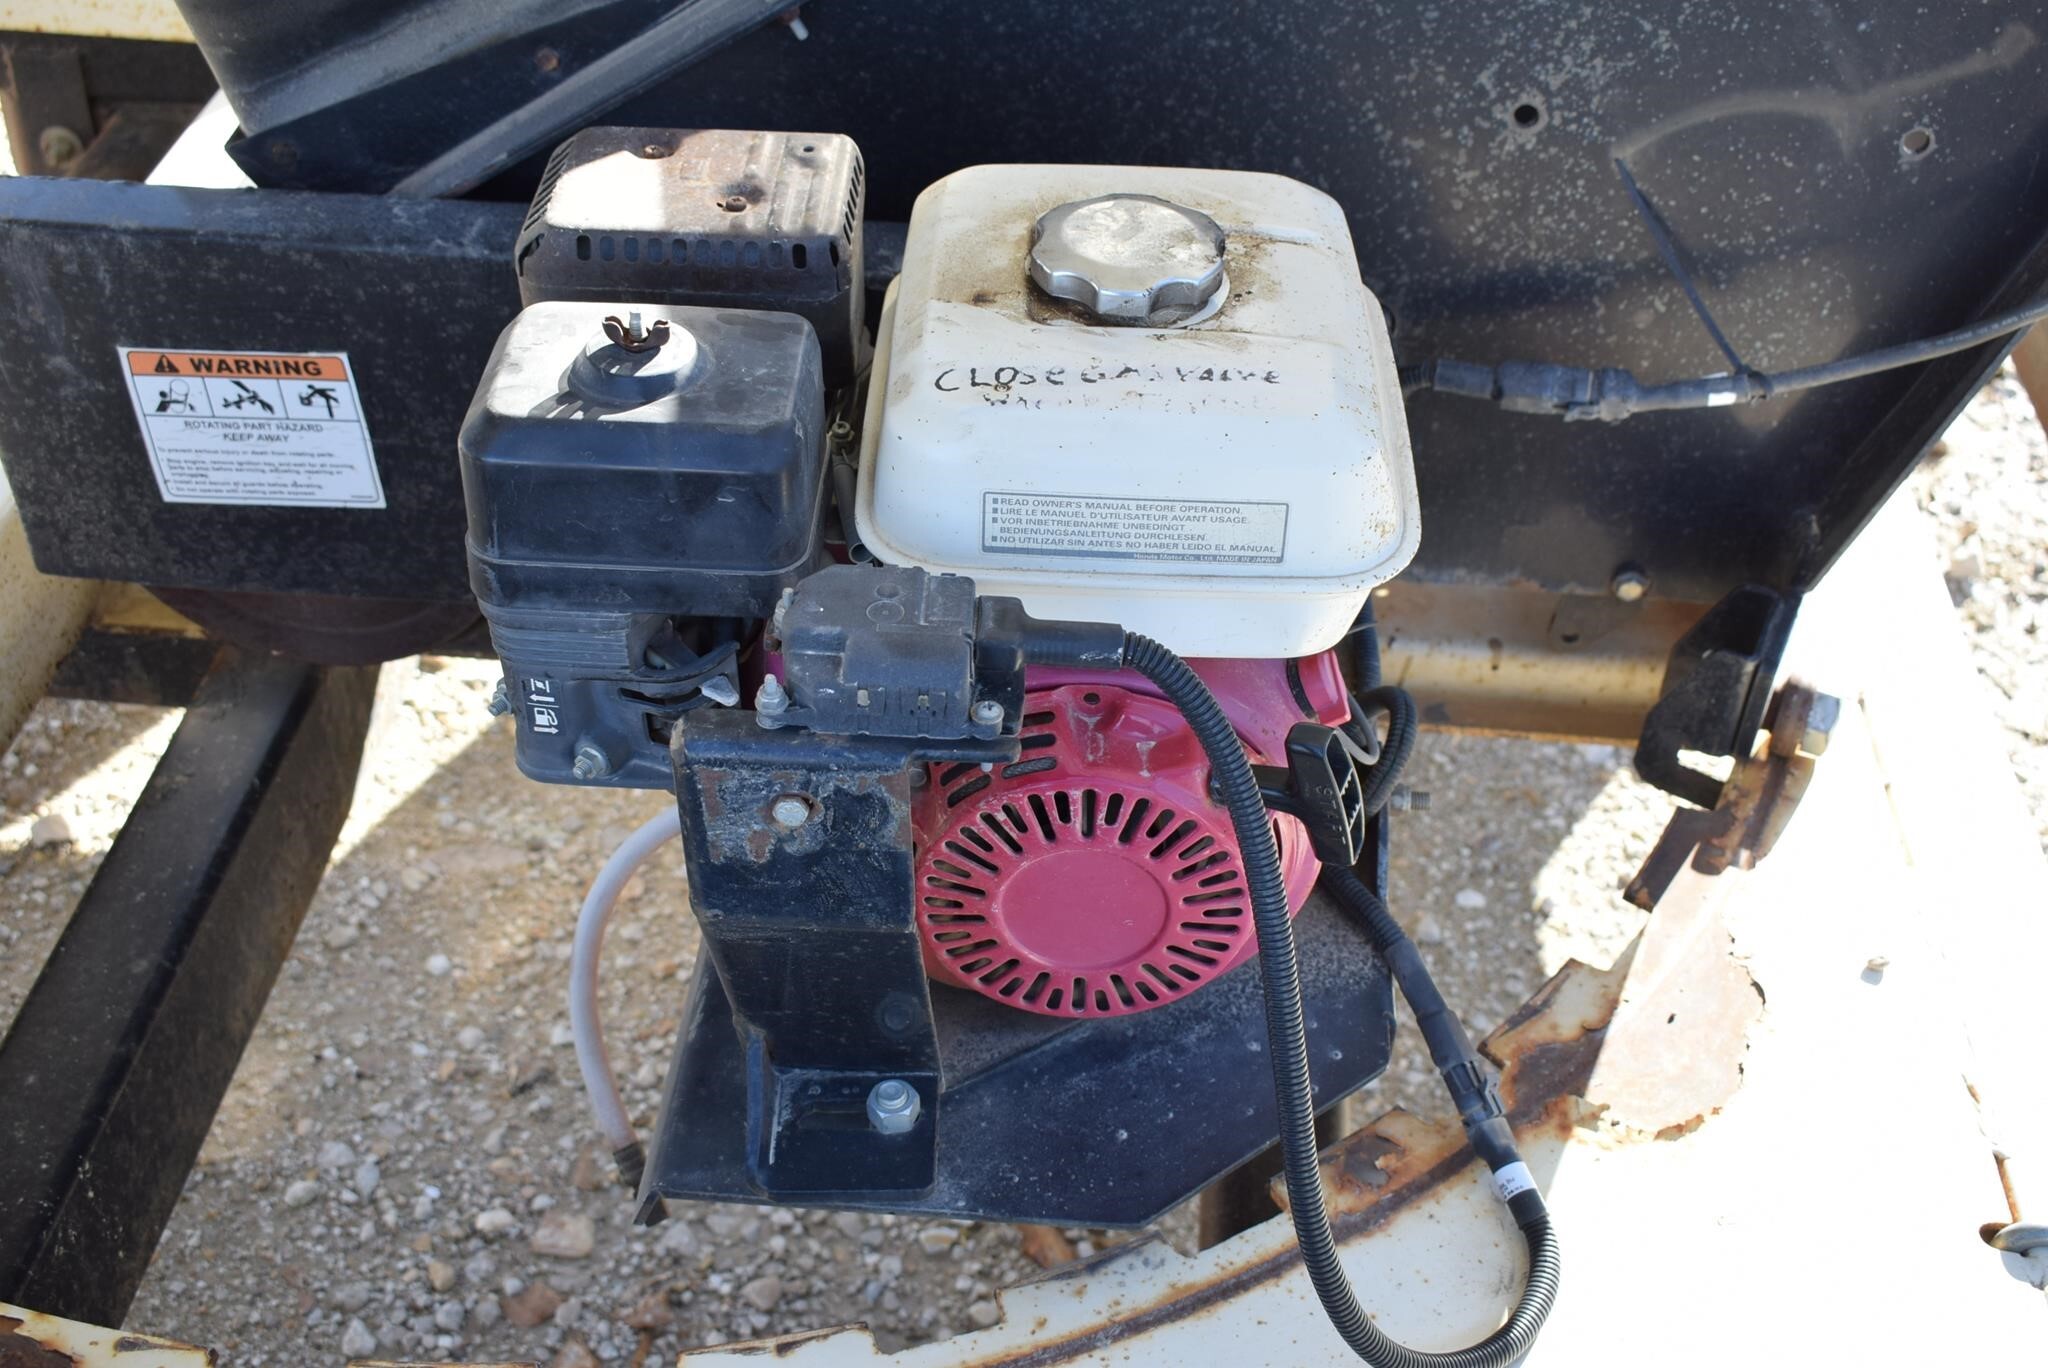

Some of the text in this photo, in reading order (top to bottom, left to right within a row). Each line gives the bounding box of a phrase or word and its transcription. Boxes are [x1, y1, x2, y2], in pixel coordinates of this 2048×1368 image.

[190, 357, 322, 376] WARNING
[935, 366, 1064, 391] CLOSE
[184, 420, 323, 432] ROTATING PART HAZARD
[223, 432, 290, 442] KEEP AWAY
[1000, 498, 1029, 506] READ
[1032, 499, 1082, 509] OWNER'S
[1085, 501, 1132, 512] MANUAL
[1135, 504, 1176, 513] BEFORE
[1000, 508, 1022, 516] LIRE
[1041, 510, 1086, 519] MANUEL
[1090, 512, 1168, 522] D'UTILISATEUR
[1000, 517, 1185, 531] VOR INBETRIEBNAHME UNBEDINGT
[1000, 526, 1131, 539] BEDIENUNGSANLEITUNG
[1000, 536, 1015, 544] NO
[1019, 536, 1064, 546] UTILIZAR
[1067, 538, 1086, 546] SIN
[1087, 540, 1122, 548] ANTES
[1126, 540, 1141, 548] NO
[1144, 542, 1179, 550] HABER
[1182, 543, 1212, 551] LEIDO
